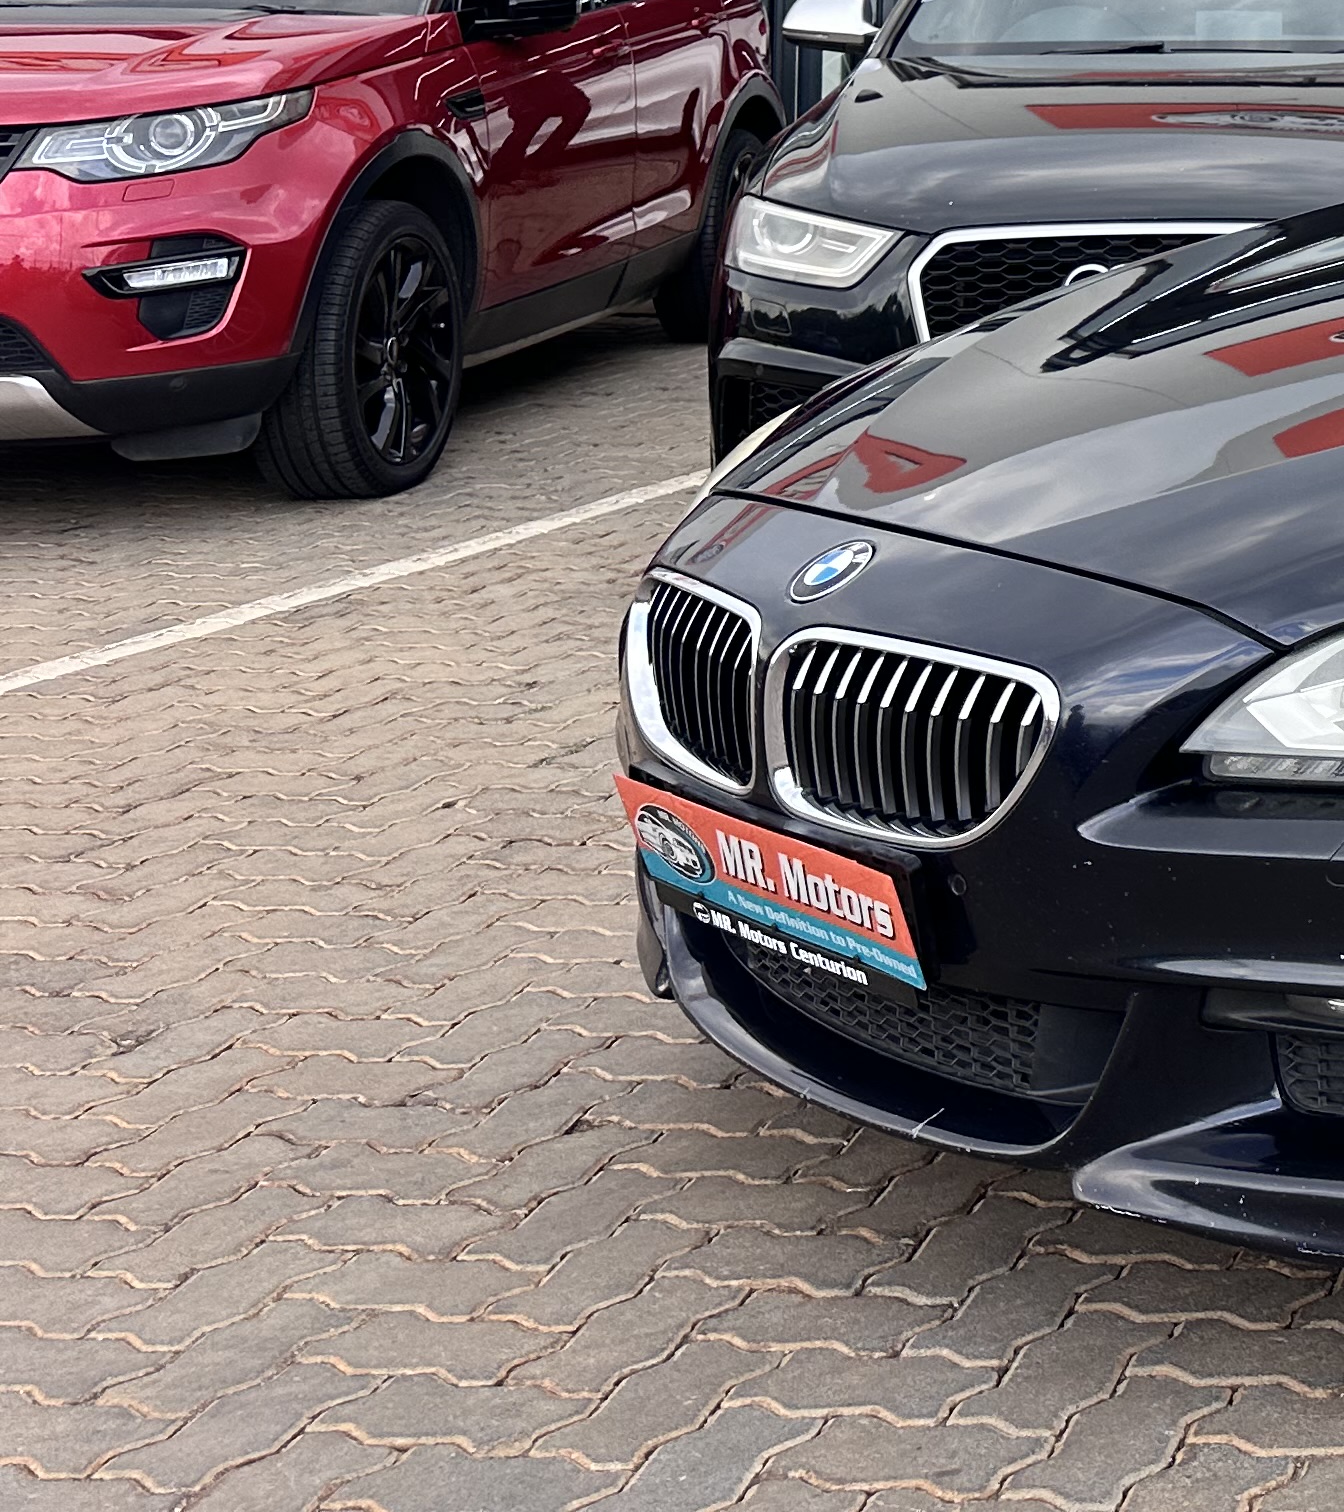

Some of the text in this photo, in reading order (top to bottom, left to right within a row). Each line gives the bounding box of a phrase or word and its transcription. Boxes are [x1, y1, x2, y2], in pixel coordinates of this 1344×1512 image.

[716, 829, 776, 893] MR.
[777, 852, 896, 938] Motors
[711, 909, 868, 985] MR. Motors Centurion
[728, 891, 918, 978] A New Definition to Pre-Owned
